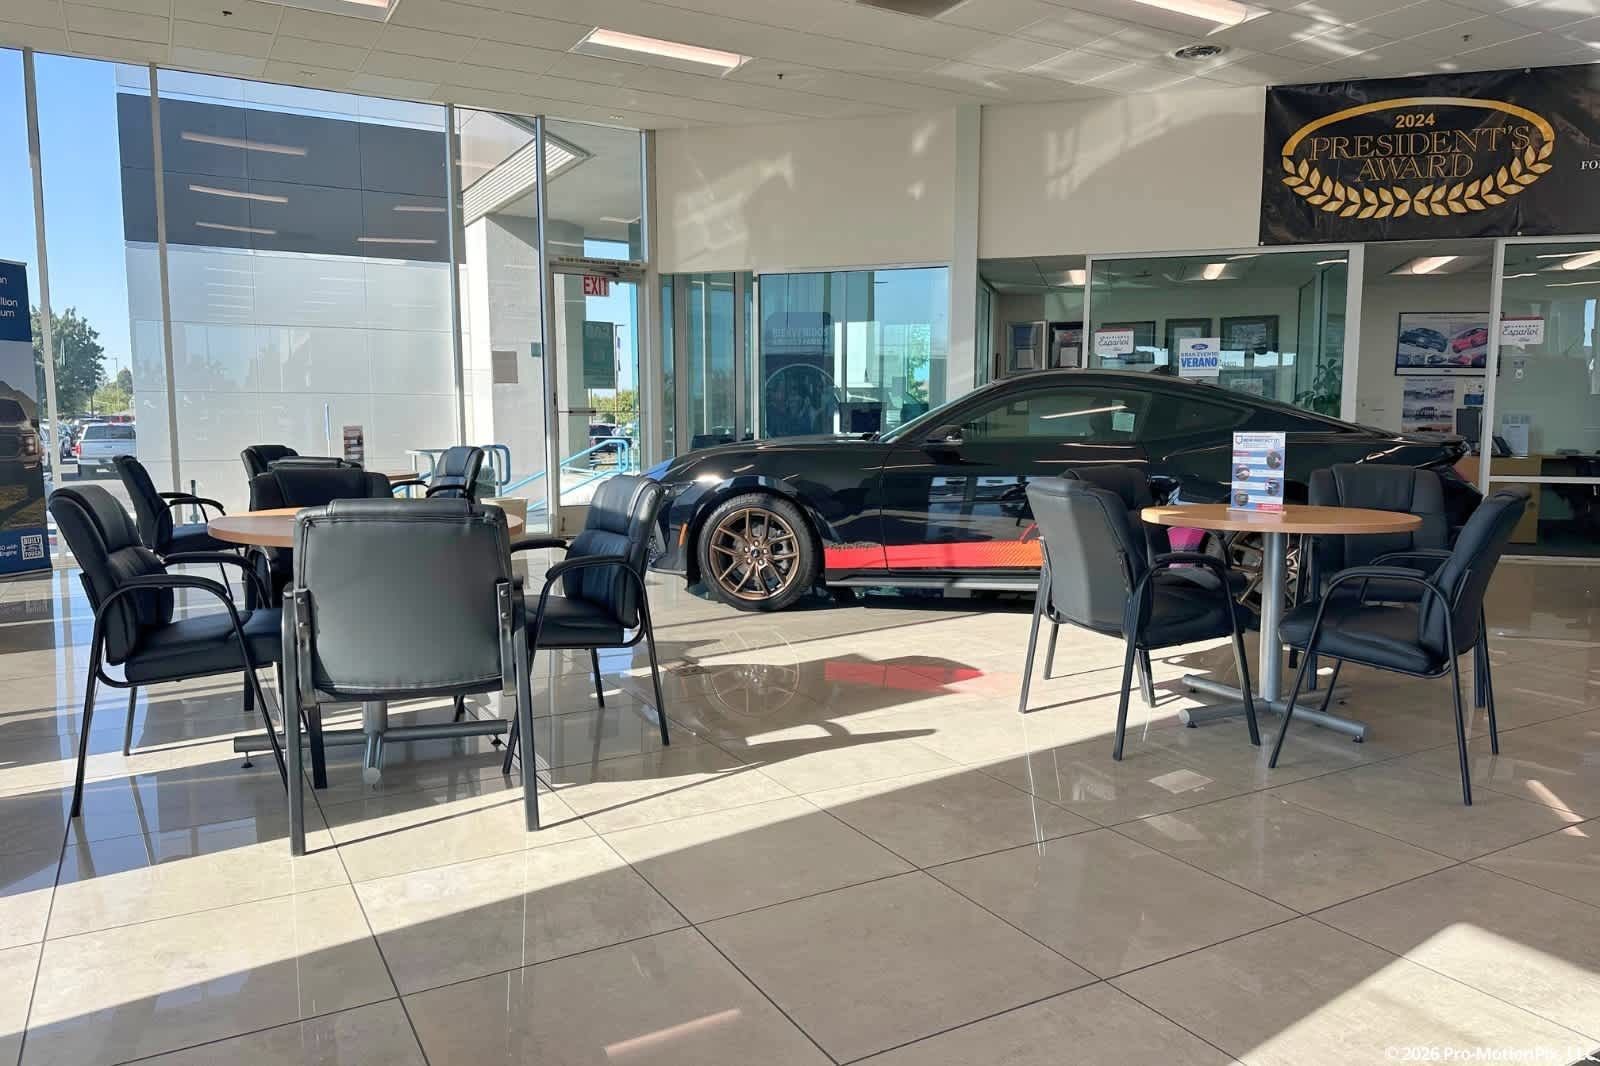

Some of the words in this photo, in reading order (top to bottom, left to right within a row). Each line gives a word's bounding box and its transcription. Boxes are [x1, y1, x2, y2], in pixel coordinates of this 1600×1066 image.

[1395, 112, 1436, 128] 2024
[1309, 126, 1530, 161] PRESIDENT'S
[1356, 154, 1474, 182] AWARD
[1580, 159, 1600, 170] FO
[584, 276, 608, 295] EXIT
[1181, 357, 1218, 368] VERANO
